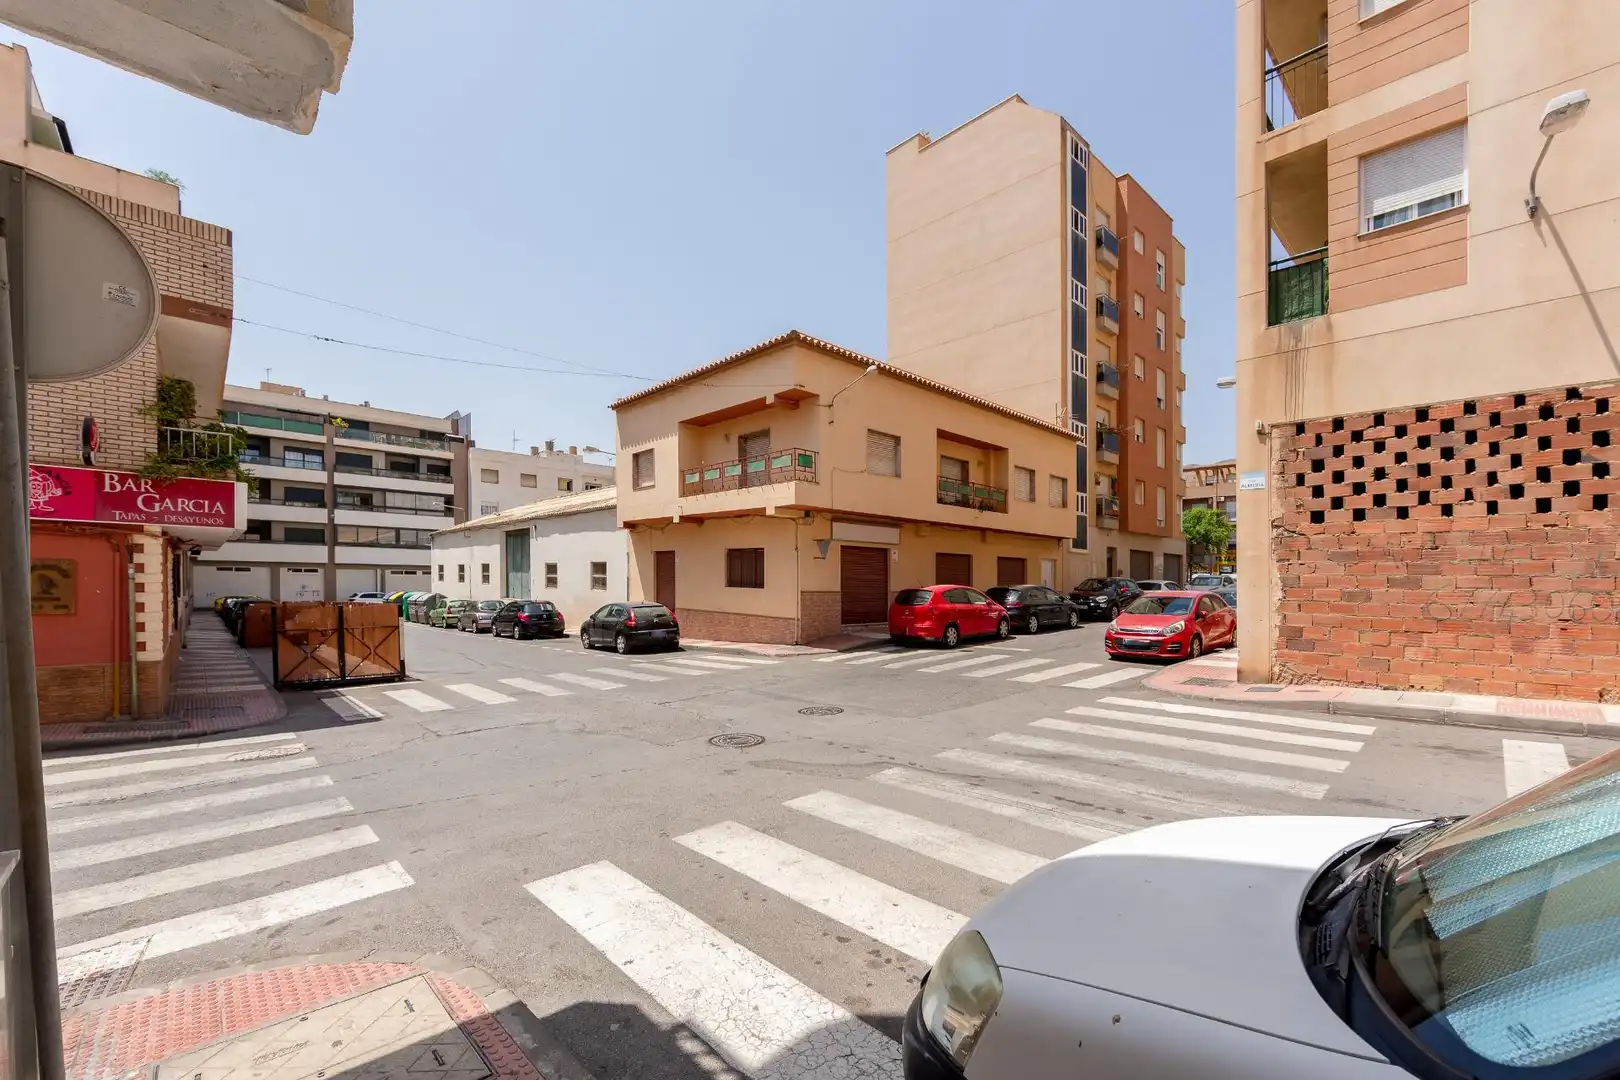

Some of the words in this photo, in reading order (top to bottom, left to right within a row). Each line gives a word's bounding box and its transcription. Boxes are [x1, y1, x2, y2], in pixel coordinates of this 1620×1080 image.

[102, 472, 157, 493] BAR
[136, 493, 226, 515] GARCIA
[112, 510, 146, 521] TAPAS
[164, 514, 224, 525] DESAYUNOS
